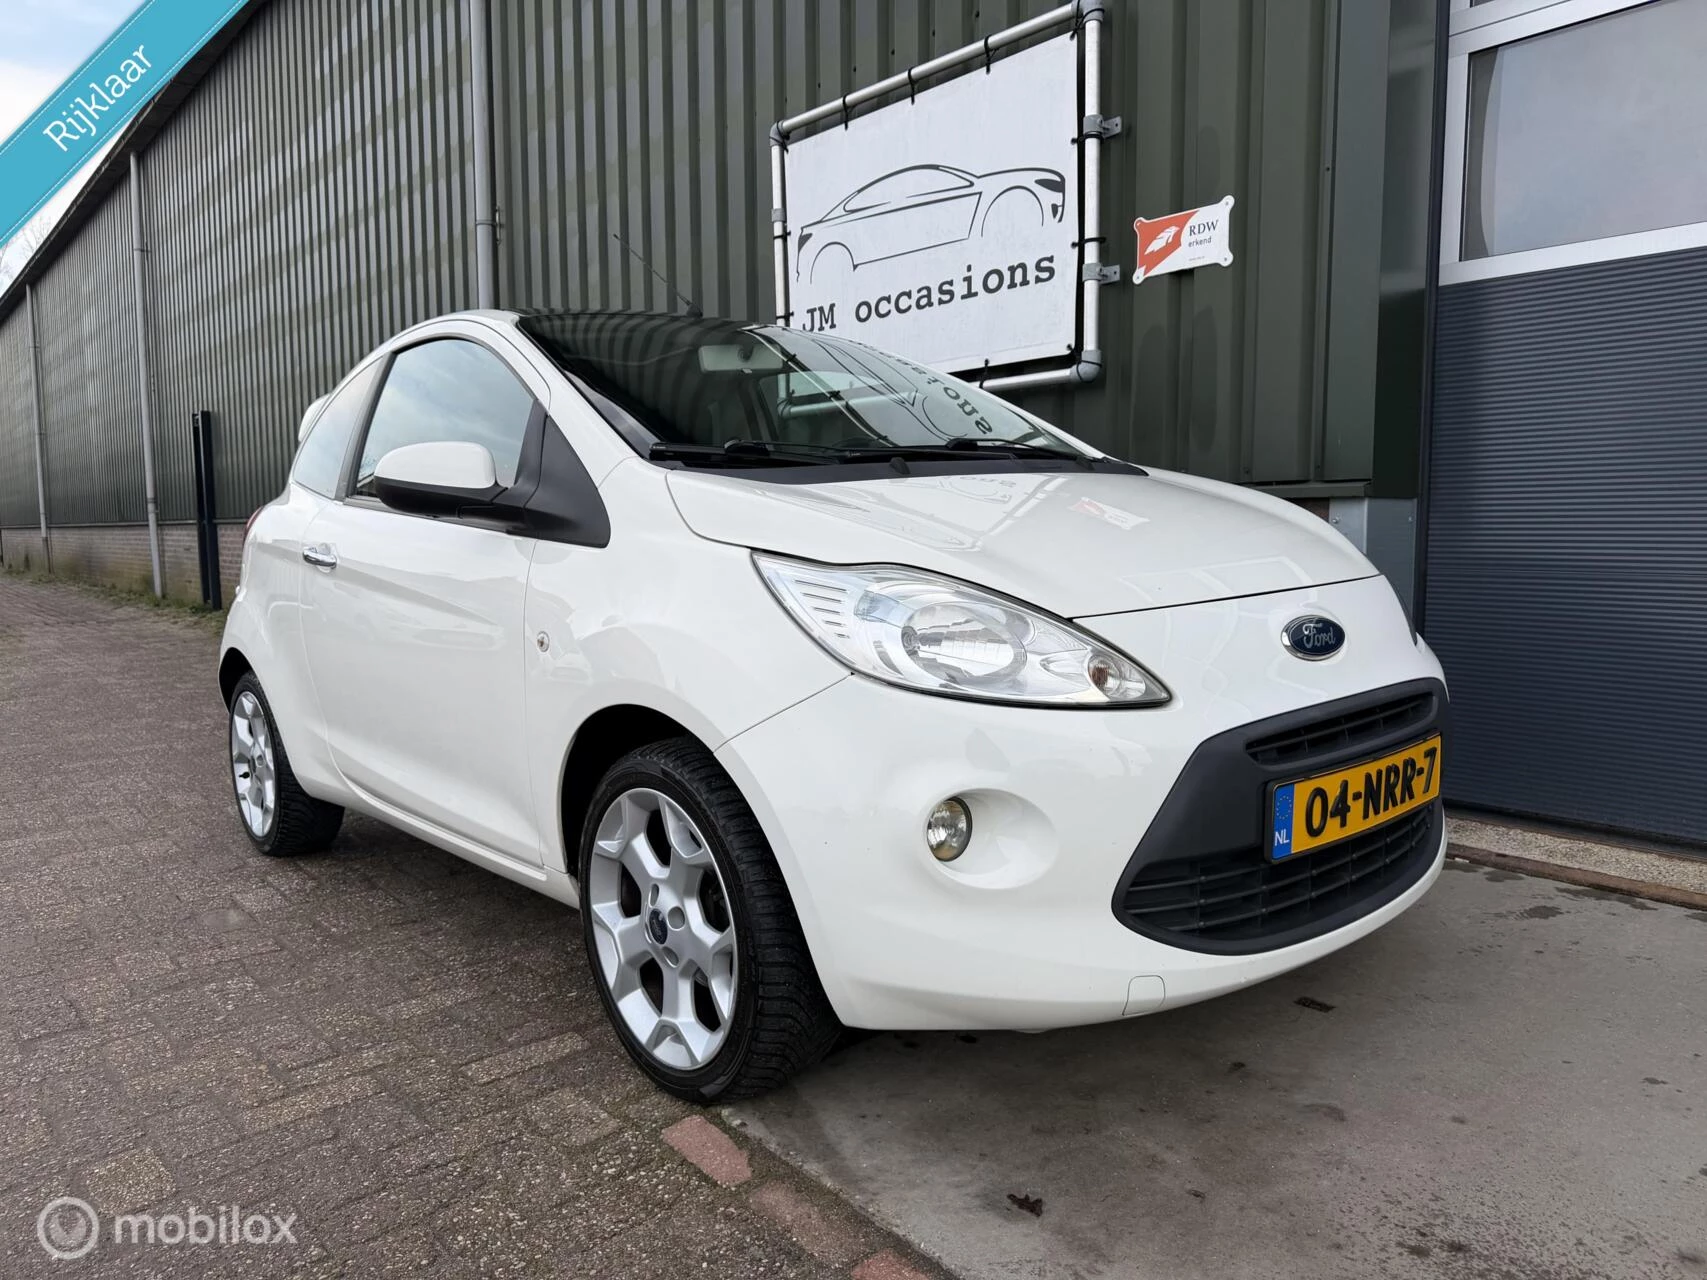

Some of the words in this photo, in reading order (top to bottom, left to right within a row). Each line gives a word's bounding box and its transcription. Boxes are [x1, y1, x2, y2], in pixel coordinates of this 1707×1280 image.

[1189, 219, 1219, 237] RDW
[1188, 236, 1212, 248] erkend
[802, 303, 837, 332] JM
[855, 255, 1056, 323] occasions
[1302, 622, 1337, 648] Ford
[1305, 746, 1437, 838] 04-NRR-7
[1274, 829, 1290, 846] NL
